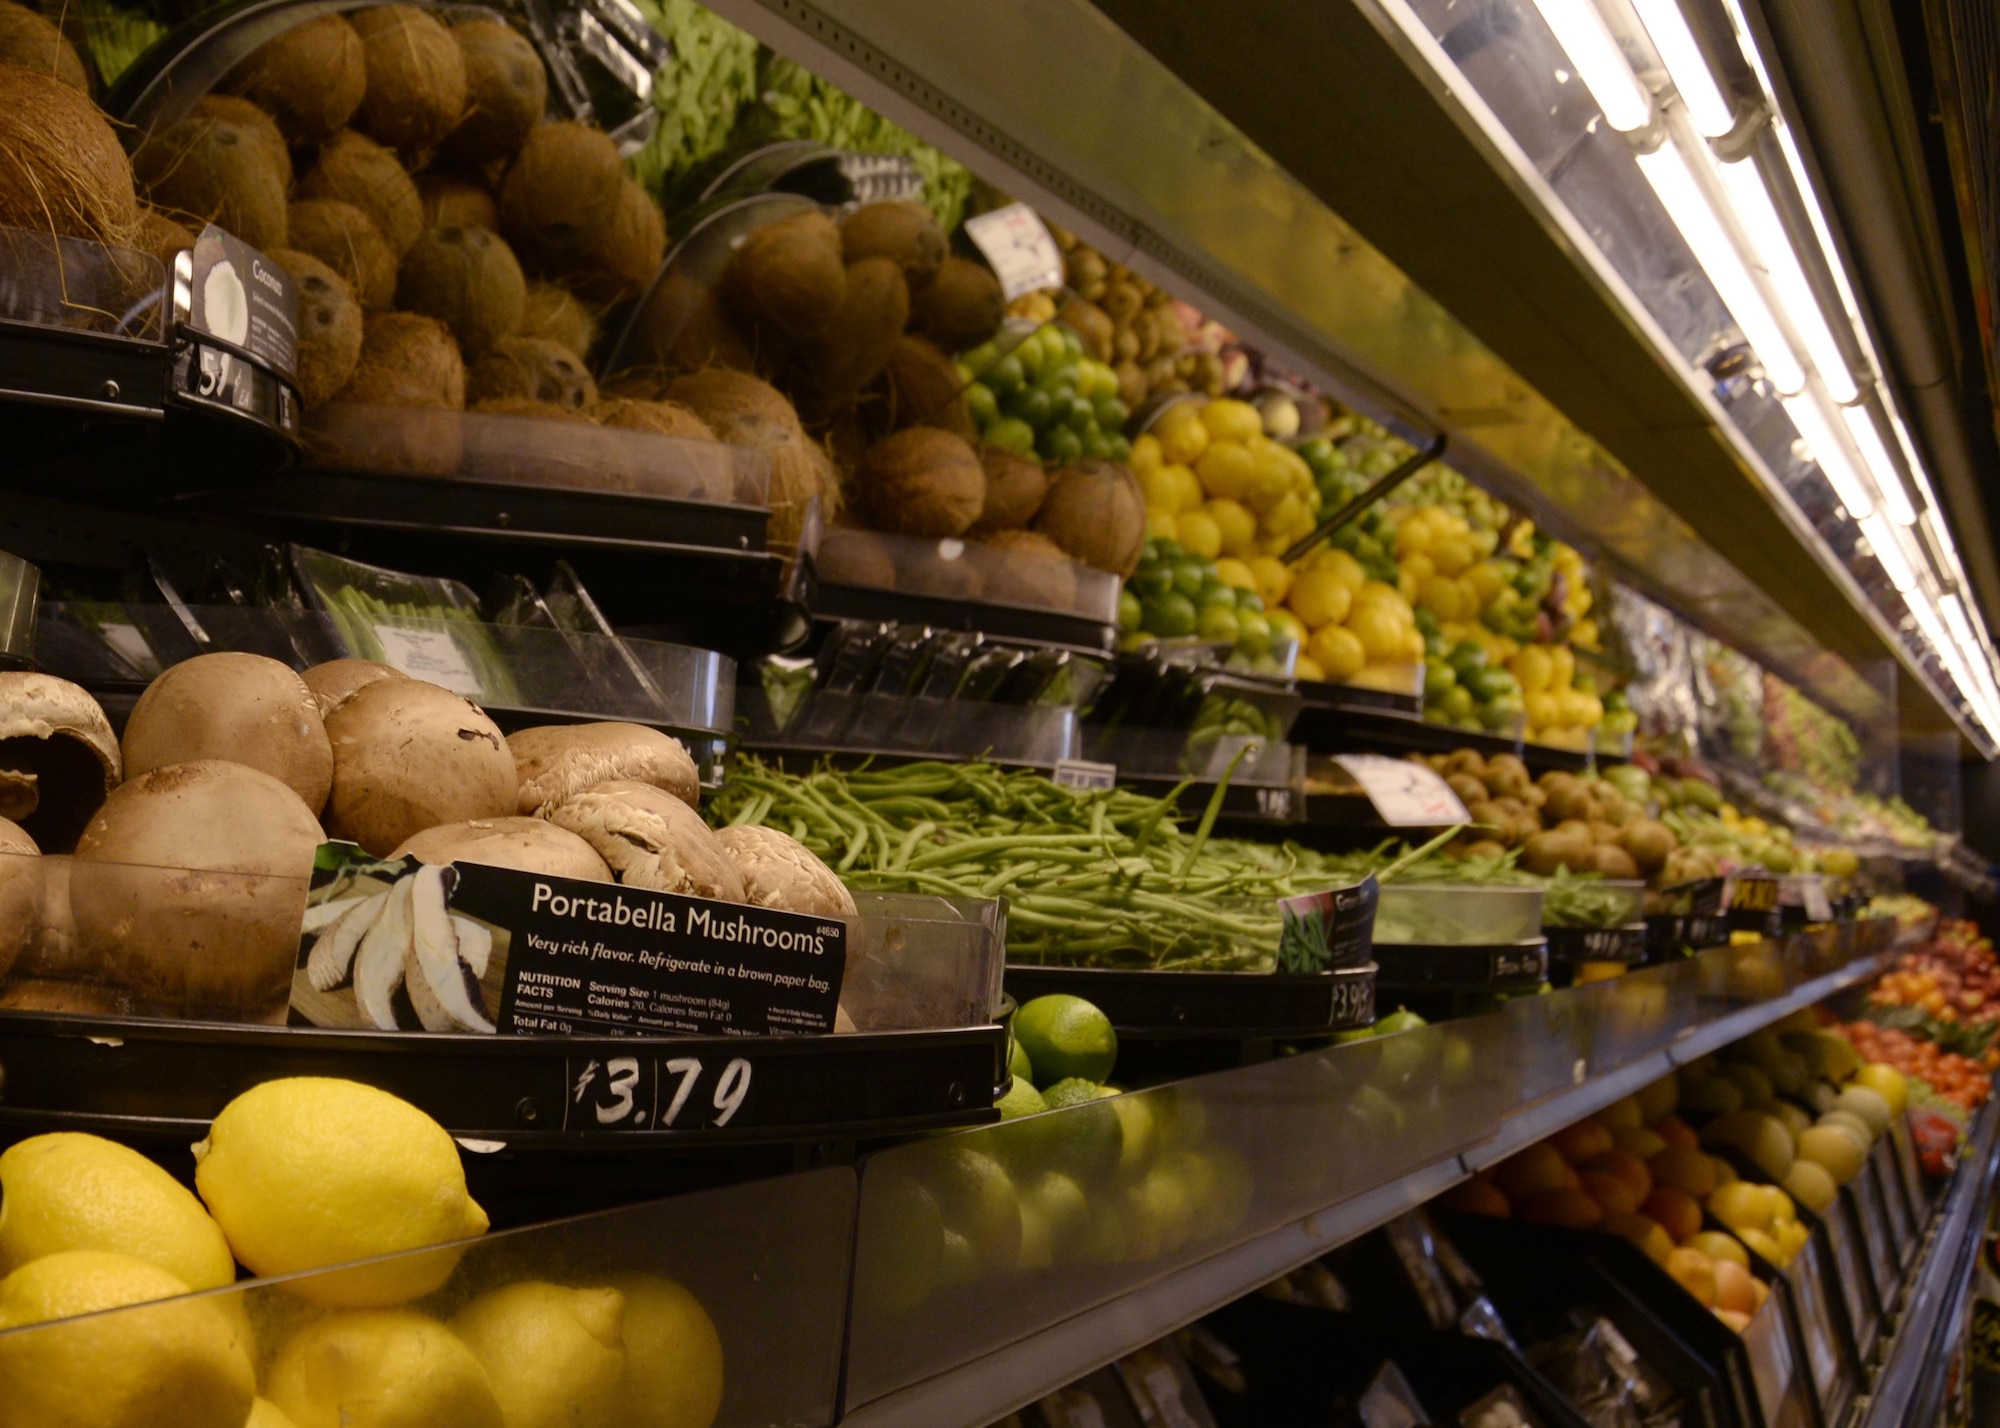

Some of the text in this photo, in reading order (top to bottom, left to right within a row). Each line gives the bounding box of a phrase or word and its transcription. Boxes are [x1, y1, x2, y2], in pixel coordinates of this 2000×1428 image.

[532, 882, 825, 956] Portabella Mushrooms
[527, 933, 831, 994] Very rich flavor. Refrigerate in a brown paper bag.
[516, 983, 554, 999] FACTS
[518, 970, 581, 990] NUTRITION
[543, 1003, 556, 1013] per
[556, 1005, 583, 1017] Serving
[587, 993, 733, 1023] Calories 20, Calories from Fat 0
[588, 980, 731, 1011] Serving Size 1 mushroom (84g)
[512, 1014, 539, 1029] Total
[540, 1018, 558, 1031] Fat
[559, 1021, 573, 1035] 0g
[572, 1056, 752, 1128] $3.79
